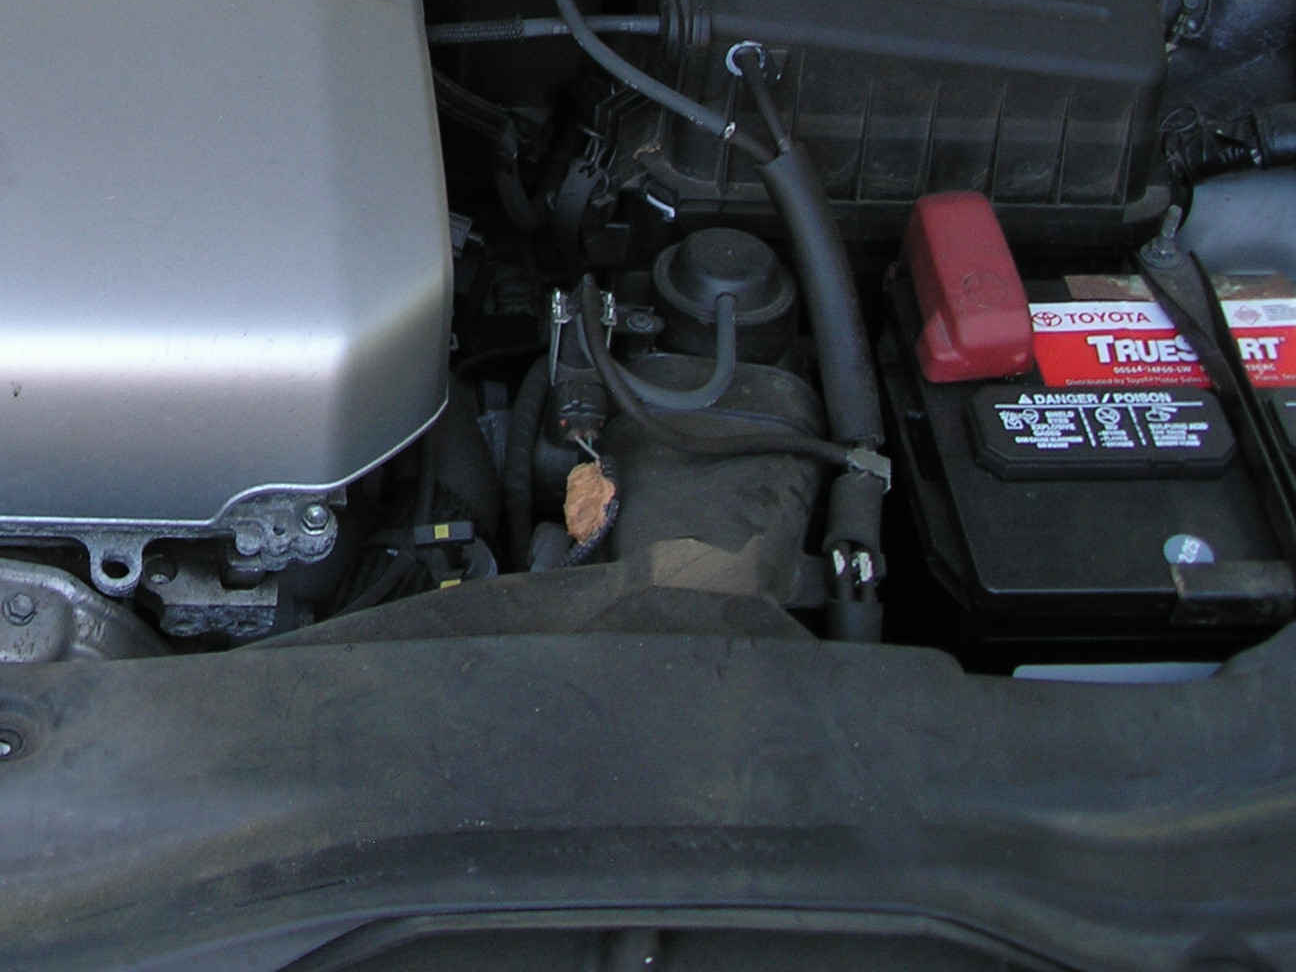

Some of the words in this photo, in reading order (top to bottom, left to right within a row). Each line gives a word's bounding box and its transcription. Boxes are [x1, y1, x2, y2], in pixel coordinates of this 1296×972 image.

[1065, 311, 1151, 325] TOYOTA
[1033, 393, 1099, 404] DANGER
[1113, 392, 1172, 403] POISON
